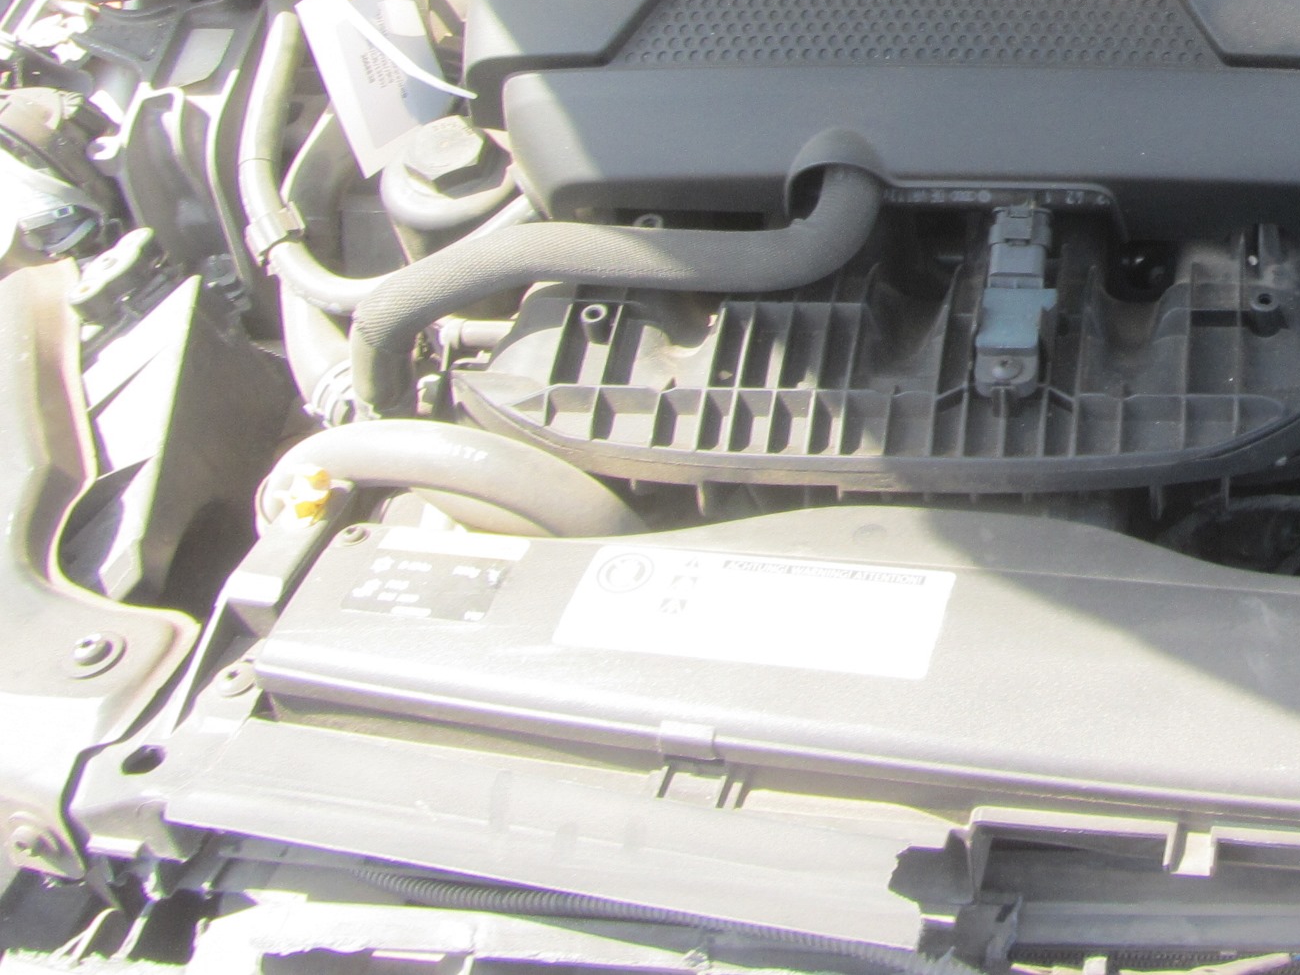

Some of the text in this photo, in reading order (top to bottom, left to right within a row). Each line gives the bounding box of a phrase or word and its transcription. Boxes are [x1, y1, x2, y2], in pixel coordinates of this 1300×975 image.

[725, 560, 924, 585] ACHTUNG! WARNING! ATTENTION!
